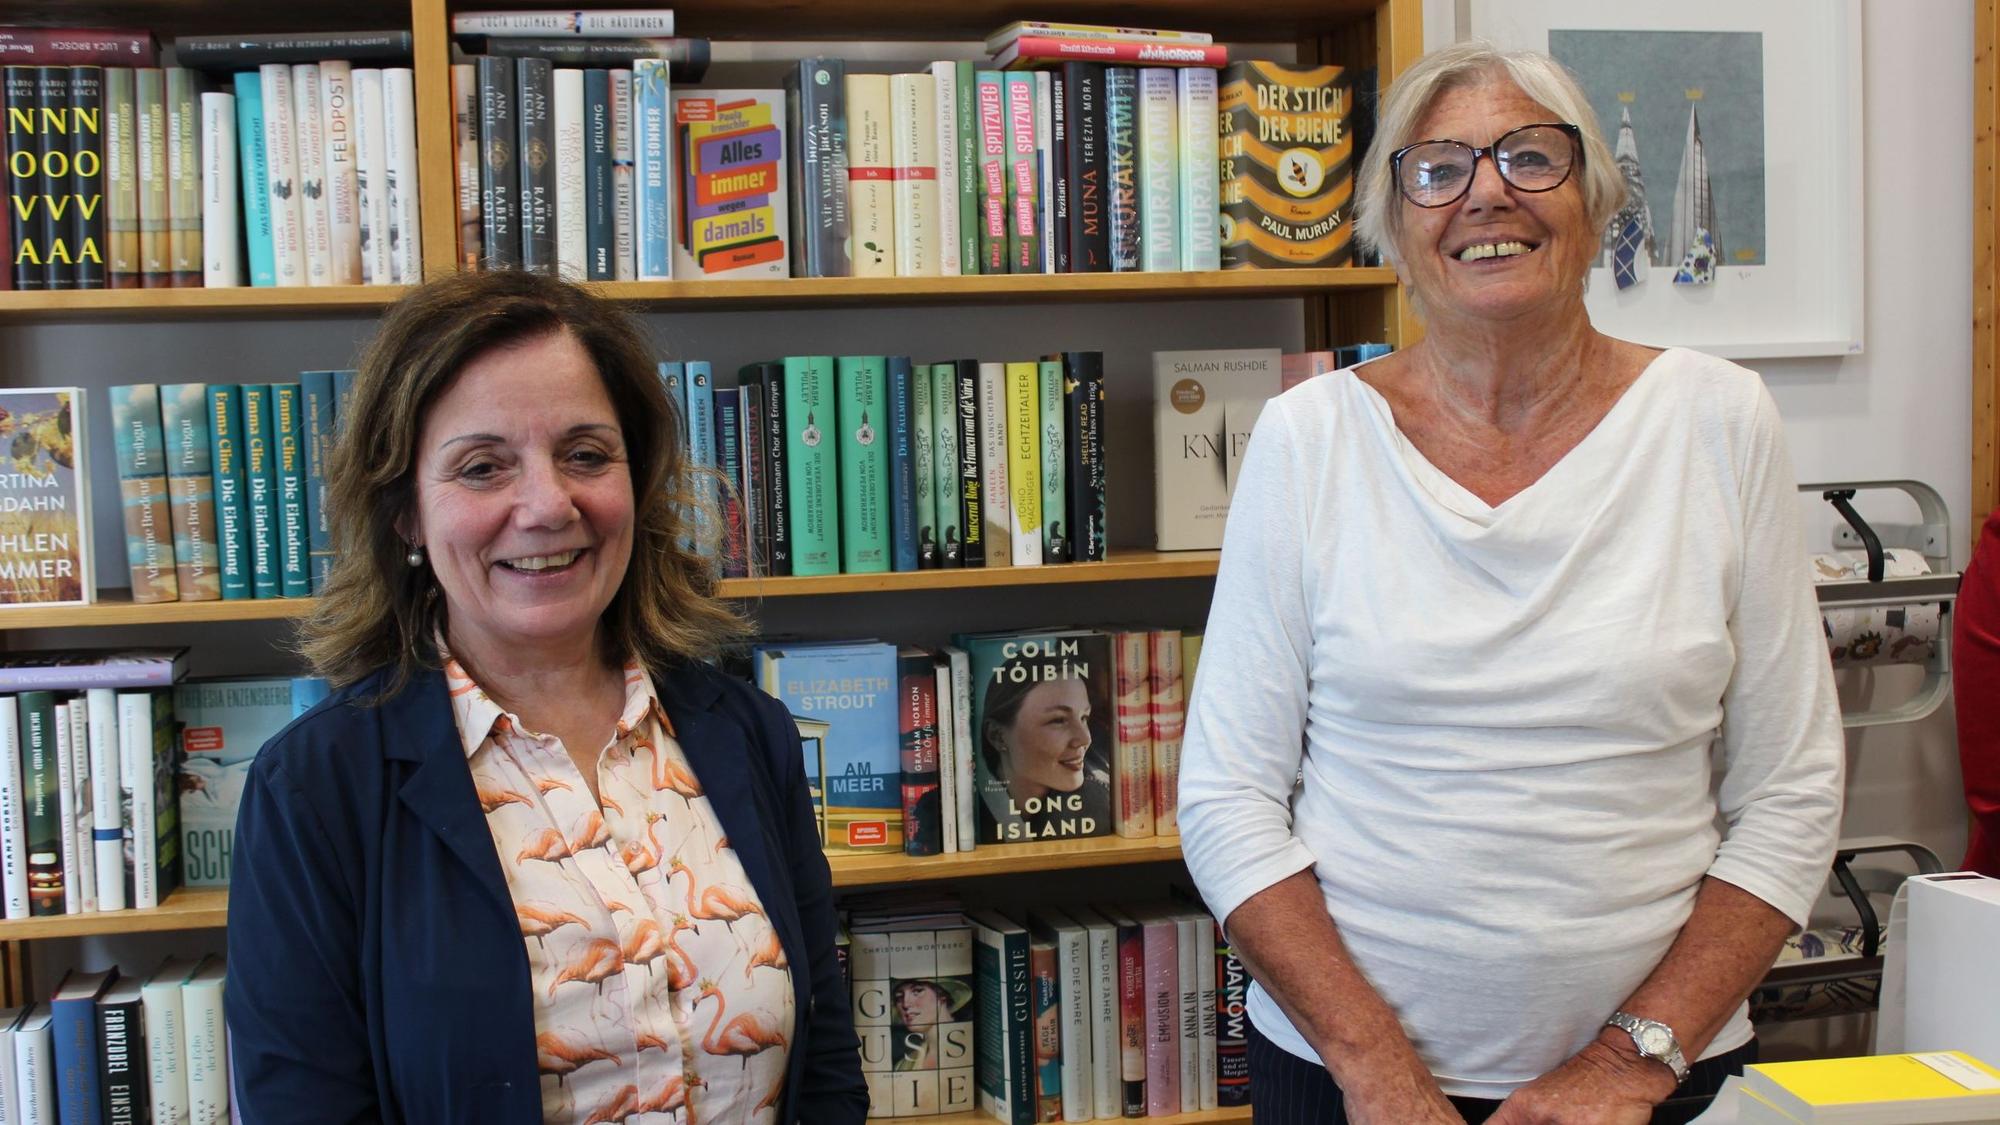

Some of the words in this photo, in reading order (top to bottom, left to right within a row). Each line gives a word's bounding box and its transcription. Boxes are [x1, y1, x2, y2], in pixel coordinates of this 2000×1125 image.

[485, 86, 495, 126] LECKIE
[497, 92, 506, 119] ANN
[524, 86, 534, 126] LECKIE
[535, 92, 546, 120] ANN
[1055, 80, 1063, 121] MORRISON
[1083, 78, 1092, 111] MORA
[1257, 84, 1289, 111] DER
[1293, 87, 1343, 114] STICH
[329, 75, 348, 162] FELDPOST
[594, 104, 604, 153] HEILUNG
[647, 107, 660, 157] SOMMER
[819, 103, 831, 151] jackson
[981, 84, 1003, 154] SPITZWEG
[1012, 85, 1033, 152] SPITZWEG
[1056, 123, 1064, 140] TONI
[1259, 116, 1291, 142] DER
[1296, 118, 1342, 144] BIENE
[720, 140, 762, 165] Alles
[807, 124, 818, 163] buzzy
[1084, 117, 1094, 163] TERÉZIA
[648, 161, 661, 187] DREI
[710, 171, 767, 196] immer
[820, 155, 831, 198] waren
[987, 162, 1002, 193] NICKEL
[1018, 161, 1032, 192] NICKEL
[1113, 95, 1136, 251] MURAKAMI
[1149, 105, 1172, 252] MURAKAMI
[1191, 105, 1213, 251] MURAKAMI
[483, 190, 493, 232] GOTT
[495, 186, 507, 234] RABEN
[522, 190, 532, 232] GOTT
[534, 186, 545, 234] RABEN
[718, 200, 746, 212] wegen
[912, 184, 921, 227] LUNDE
[1058, 177, 1067, 217] Rezitativ
[1083, 170, 1098, 236] MUNA
[704, 213, 765, 243] damals
[822, 202, 833, 228] wir
[989, 199, 1002, 237] ECKHART
[1019, 196, 1033, 235] ECKHART
[1261, 215, 1292, 239] PAUL
[1296, 210, 1342, 240] MURRAY
[913, 236, 922, 269] MAJA
[1174, 362, 1219, 373] SALMAN
[1224, 361, 1268, 371] RUSHDIE
[770, 381, 778, 418] Erinnyen
[801, 371, 809, 403] PULLEY
[810, 369, 818, 407] NATASHA
[855, 370, 863, 402] PULLEY
[865, 369, 873, 405] NATASHA
[897, 373, 906, 433] FALLMEISTER
[962, 378, 974, 400] Núria
[215, 392, 228, 435] Emma
[248, 391, 259, 434] Emma
[279, 390, 291, 432] Emma
[960, 401, 976, 418] Café
[987, 379, 995, 438] UNSICHTBARE
[1019, 374, 1031, 460] ECHTZEITALTER
[133, 420, 148, 468] Treibgut
[181, 418, 194, 467] Treibgut
[771, 420, 779, 436] der
[966, 419, 975, 436] vom
[219, 439, 231, 474] Cline
[252, 438, 263, 472] Cline
[282, 436, 295, 471] Cline
[772, 437, 780, 458] Chor
[898, 437, 908, 456] DER
[965, 438, 976, 464] Frauen
[1081, 429, 1089, 465] SHELLEY
[284, 477, 296, 499] Die
[773, 461, 783, 509] Poschmann
[964, 465, 977, 478] Die
[989, 470, 997, 504] HANEEN
[139, 480, 153, 526] Brodeur
[186, 478, 198, 525] Brodeur
[222, 479, 234, 501] Die
[254, 479, 265, 501] Die
[966, 480, 979, 499] Roig
[1018, 488, 1026, 518] TONIO
[1027, 470, 1036, 534] SCHACHINGER
[255, 505, 269, 574] Einladung
[286, 503, 299, 572] Einladung
[776, 512, 784, 541] Marion
[966, 502, 980, 544] Montserrat
[142, 528, 159, 579] Adrienne
[189, 526, 204, 577] Adrienne
[223, 506, 239, 576] Einladung
[1002, 639, 1079, 658] COLM
[788, 678, 889, 694] ELIZABETH
[992, 659, 1089, 684] TÓIBÍN
[802, 694, 876, 711] STROUT
[923, 719, 934, 733] für
[923, 734, 931, 748] Ort
[914, 729, 922, 772] GRAHAM
[924, 749, 932, 763] Ein
[833, 777, 885, 793] MEER
[844, 761, 872, 776] AM
[2, 786, 11, 832] DOBLER
[1008, 794, 1083, 815] LONG
[996, 817, 1096, 840] ISLAND
[5, 837, 14, 875] FRANZ
[862, 946, 913, 954] CHRISTOPH
[917, 942, 963, 952] WORTBERG
[1071, 941, 1080, 962] ALL
[1102, 939, 1111, 960] ALL
[1012, 949, 1028, 1022] GUSSIE
[1072, 967, 1080, 984] DIE
[1102, 964, 1111, 982] DIE
[1074, 990, 1082, 1025] JAHRE
[1103, 987, 1112, 1023] JAHRE
[1184, 991, 1196, 1003] IN
[1202, 990, 1215, 1001] IN
[165, 1010, 176, 1054] Gezeiten
[206, 1008, 216, 1053] Gezeiten
[1158, 991, 1170, 1042] EMPUSION
[1184, 1007, 1198, 1039] ANNA
[1203, 1005, 1216, 1037] ANNA
[105, 1009, 129, 1073] FRANZOBEL
[153, 1036, 162, 1061] Echo
[193, 1034, 202, 1060] Echo
[155, 1064, 163, 1083] Das
[168, 1057, 177, 1073] der
[194, 1062, 204, 1081] Das
[208, 1056, 217, 1071] der
